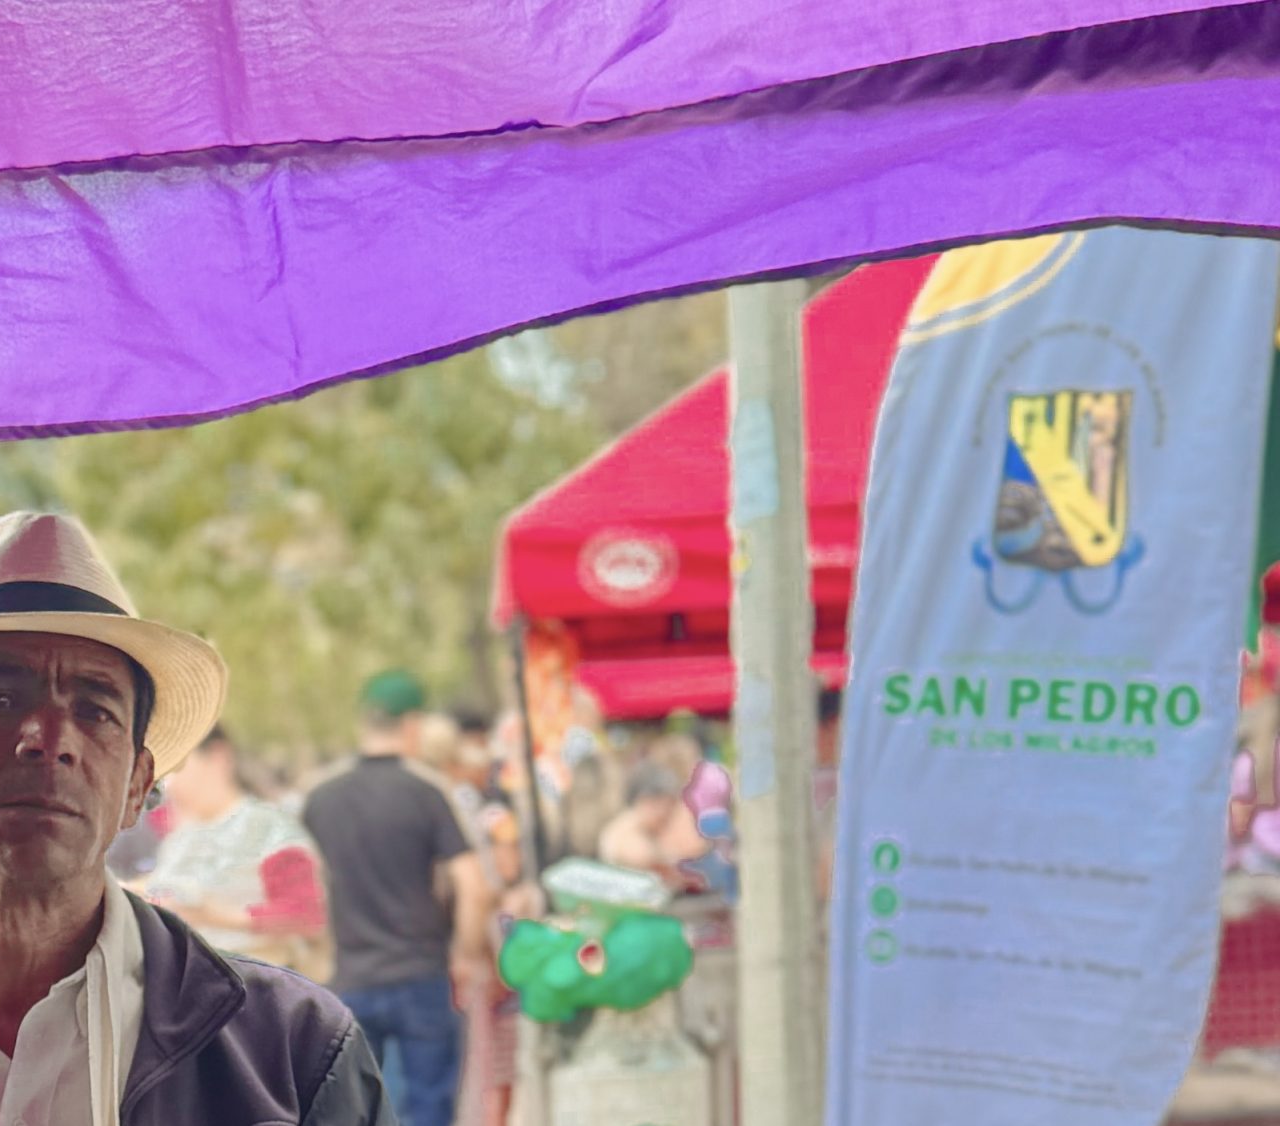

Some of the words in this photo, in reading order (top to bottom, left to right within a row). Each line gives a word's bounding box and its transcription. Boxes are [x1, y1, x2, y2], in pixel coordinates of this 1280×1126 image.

[883, 674, 987, 717] SAN
[1008, 678, 1201, 727] PEDRO
[928, 727, 957, 748] DE
[969, 730, 1013, 749] LOS
[1024, 733, 1156, 756] MILAGROS
